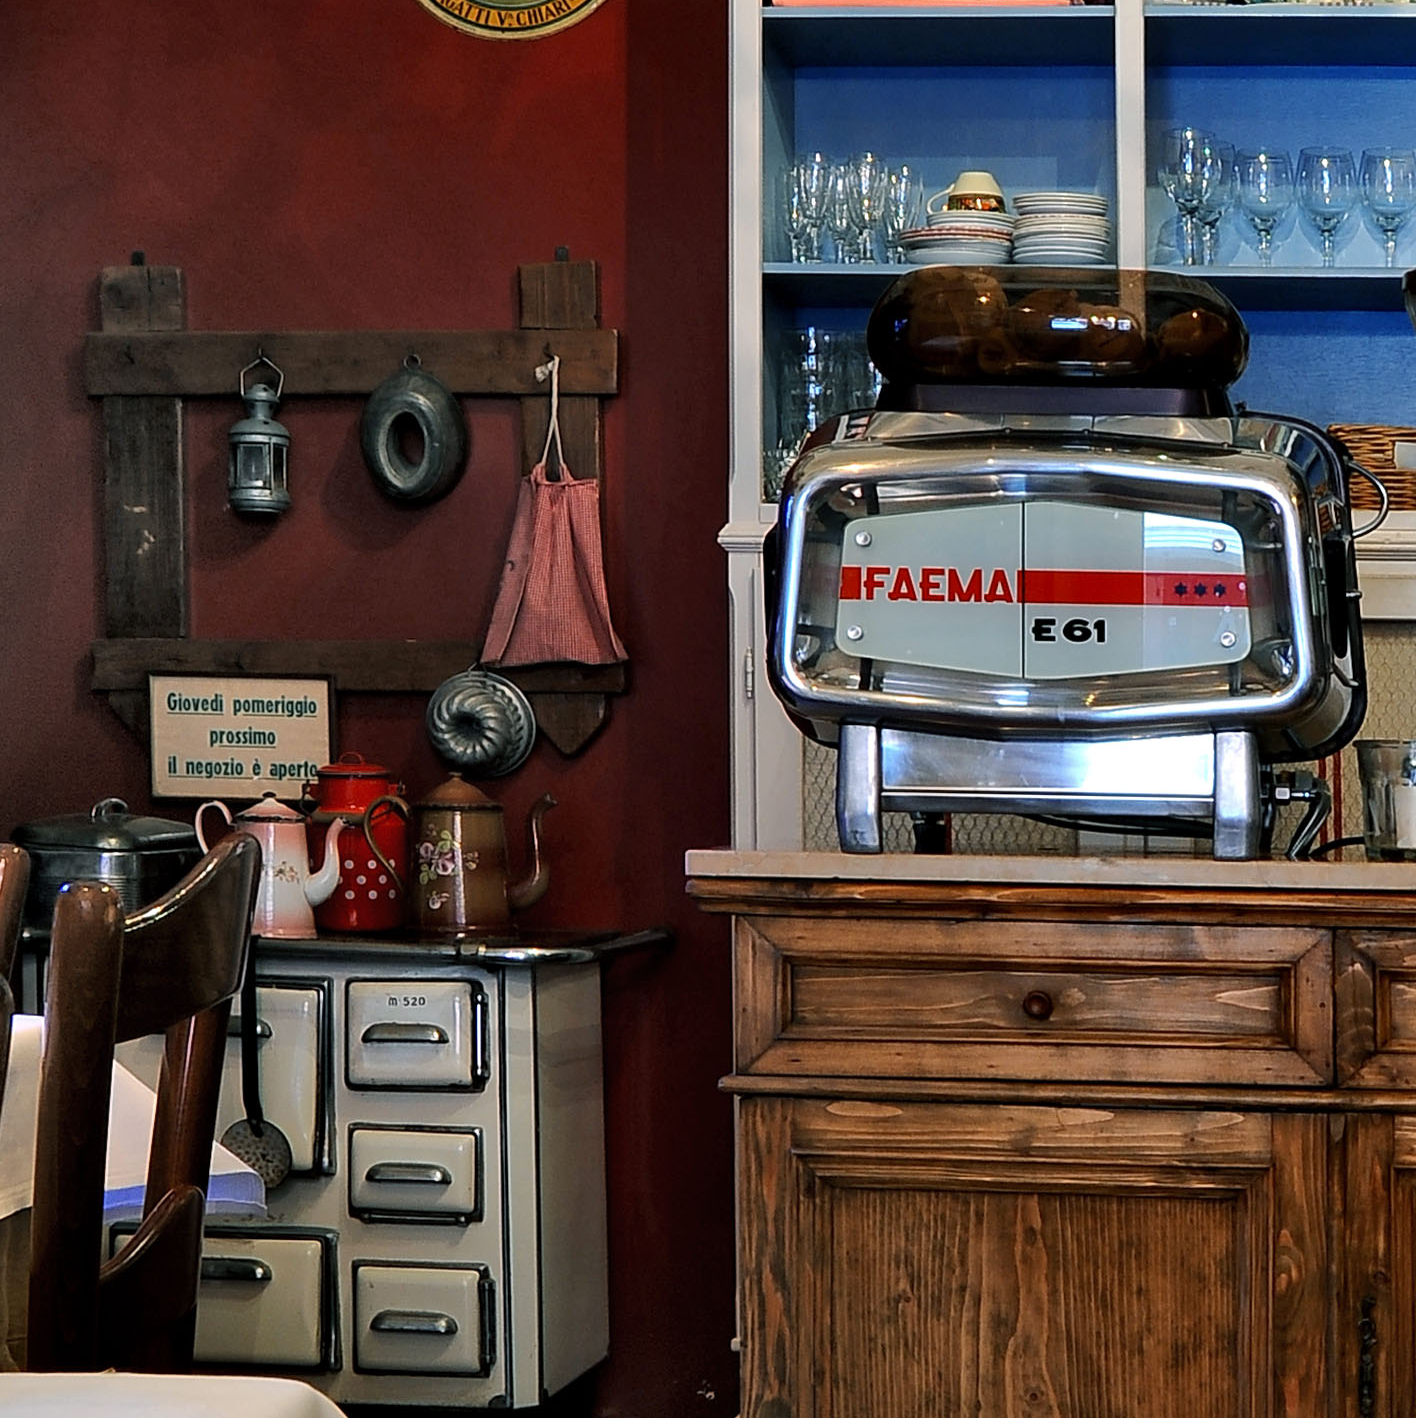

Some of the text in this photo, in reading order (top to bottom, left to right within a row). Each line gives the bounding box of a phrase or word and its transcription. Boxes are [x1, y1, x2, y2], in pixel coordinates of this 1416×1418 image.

[863, 566, 1014, 603] FAEMA
[233, 695, 317, 718] pomeriggio
[209, 726, 276, 747] prossimo
[168, 756, 319, 781] il negozio è aperto
[403, 996, 426, 1007] 520
